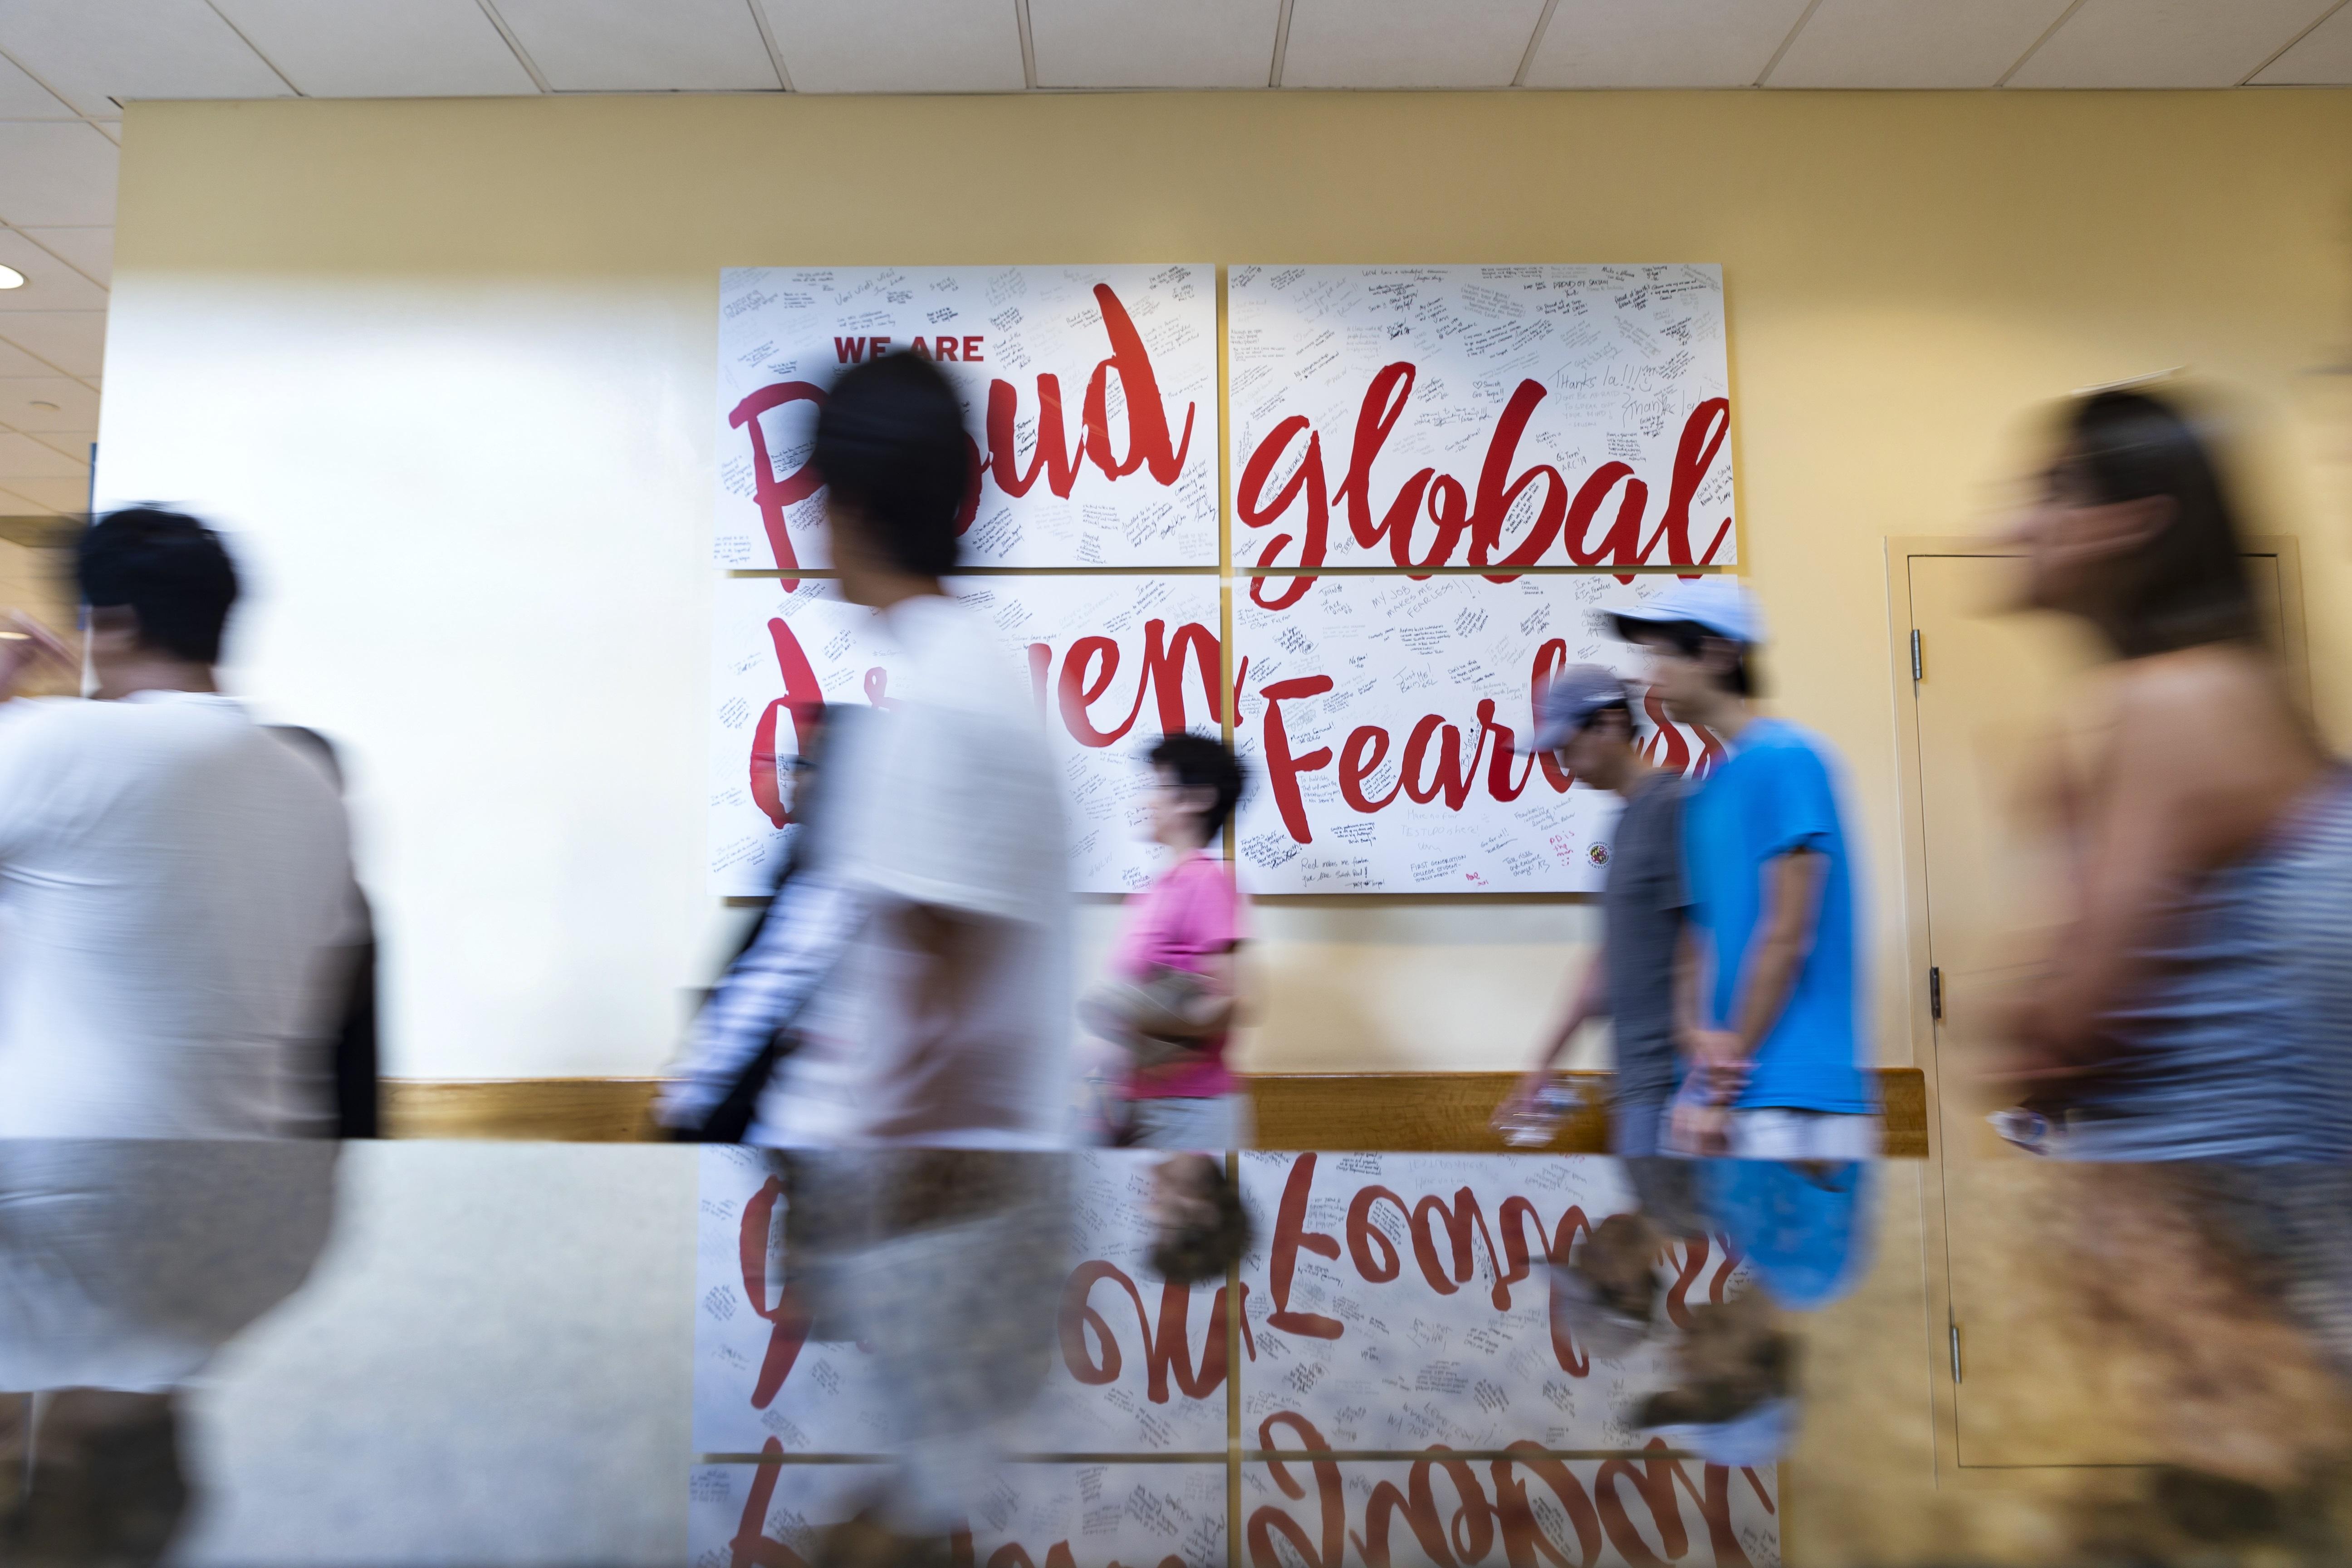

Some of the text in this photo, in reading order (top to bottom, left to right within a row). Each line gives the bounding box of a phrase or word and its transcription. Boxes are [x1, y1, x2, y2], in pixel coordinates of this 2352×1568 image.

[1553, 281, 1576, 289] PROUD
[834, 336, 984, 364] WE ARE
[729, 283, 1195, 593] Pud
[1236, 361, 1734, 609] global
[1372, 585, 1411, 609] MY JOB
[1386, 583, 1432, 618] MAKES ME
[1581, 609, 1602, 619] Always
[1291, 732, 1310, 742] Moving
[1407, 809, 1427, 820] Have
[1401, 825, 1444, 837] TESTUDO
[1553, 843, 1568, 852] the
[1586, 841, 1607, 851] UNIVERSITY
[1301, 858, 1319, 872] Red
[1411, 862, 1428, 872] FIRST
[1413, 868, 1435, 877] COLLEGE
[1415, 874, 1433, 883] TOTALLY
